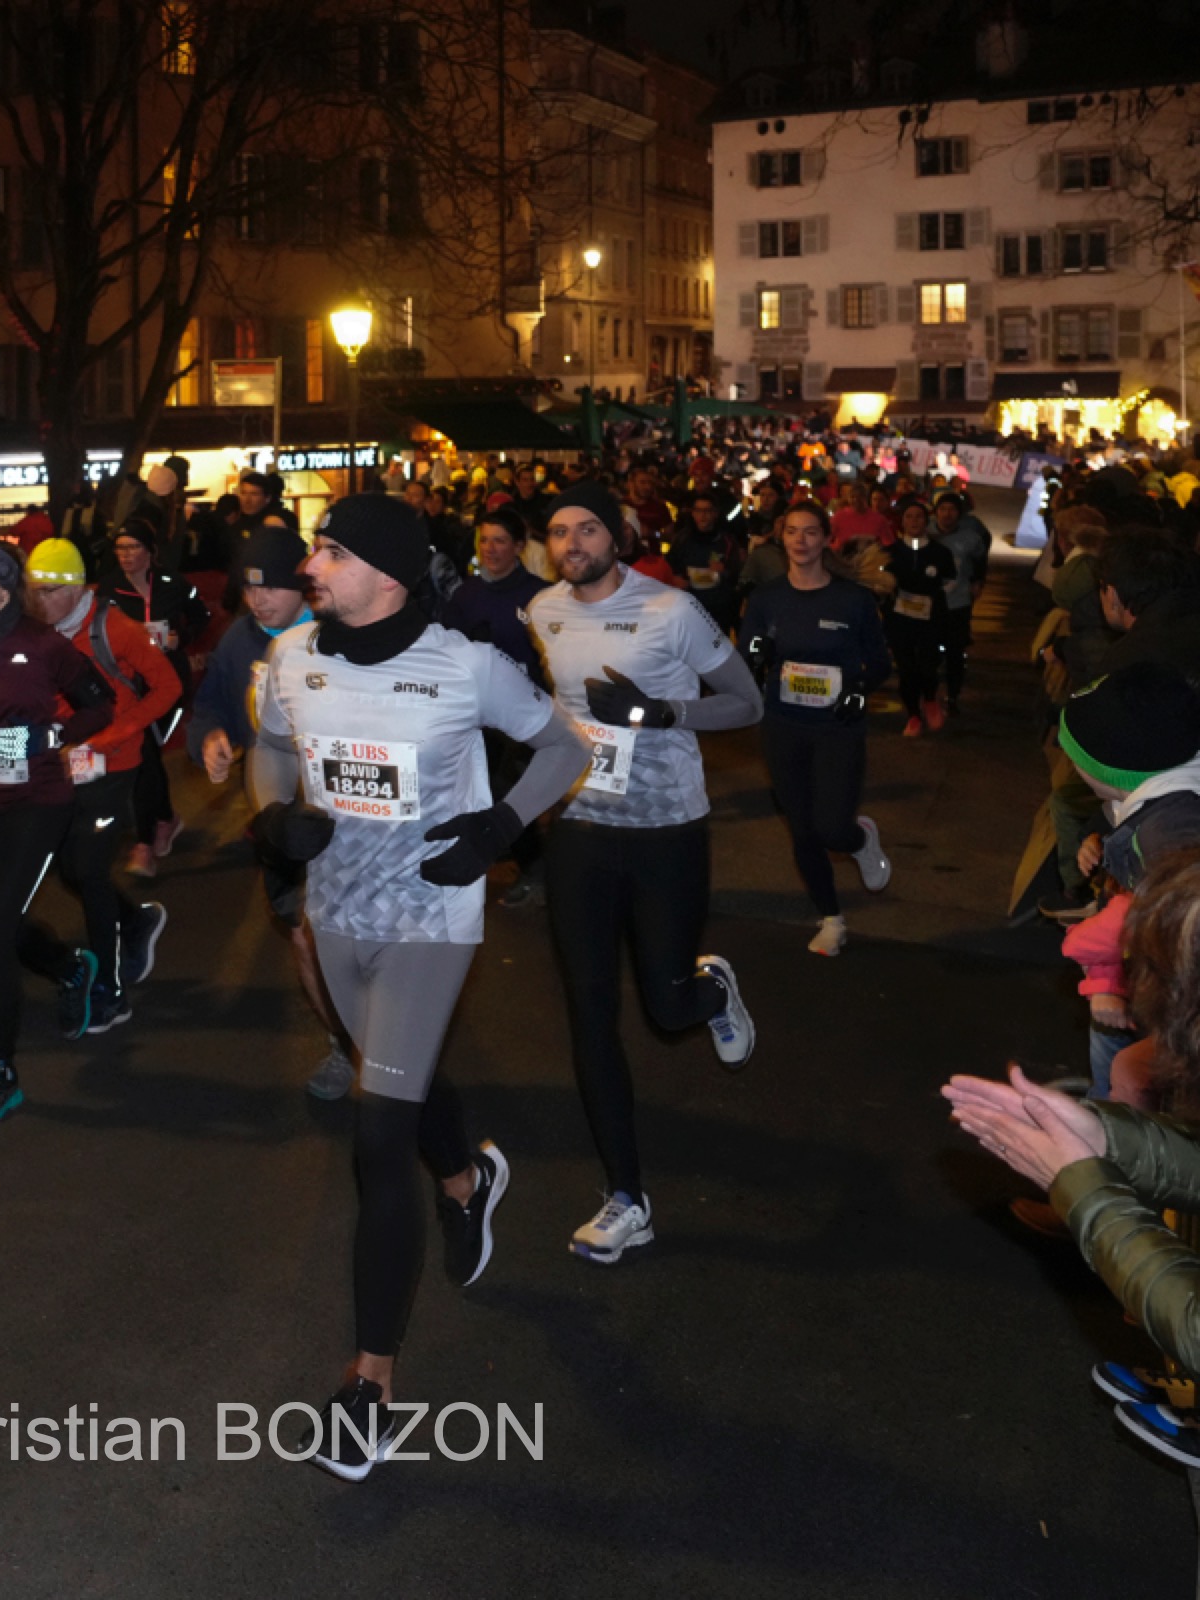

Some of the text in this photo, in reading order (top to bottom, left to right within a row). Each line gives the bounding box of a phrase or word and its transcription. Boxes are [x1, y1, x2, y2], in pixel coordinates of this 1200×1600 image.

[278, 453, 306, 470] OLD
[308, 451, 343, 468] TOWN
[977, 455, 1014, 478] UBS
[604, 622, 638, 633] amag
[393, 681, 439, 698] amag
[352, 743, 389, 762] UBS
[341, 763, 379, 779] DAVID
[330, 776, 395, 799] 18494
[333, 797, 392, 816] MIGROS
